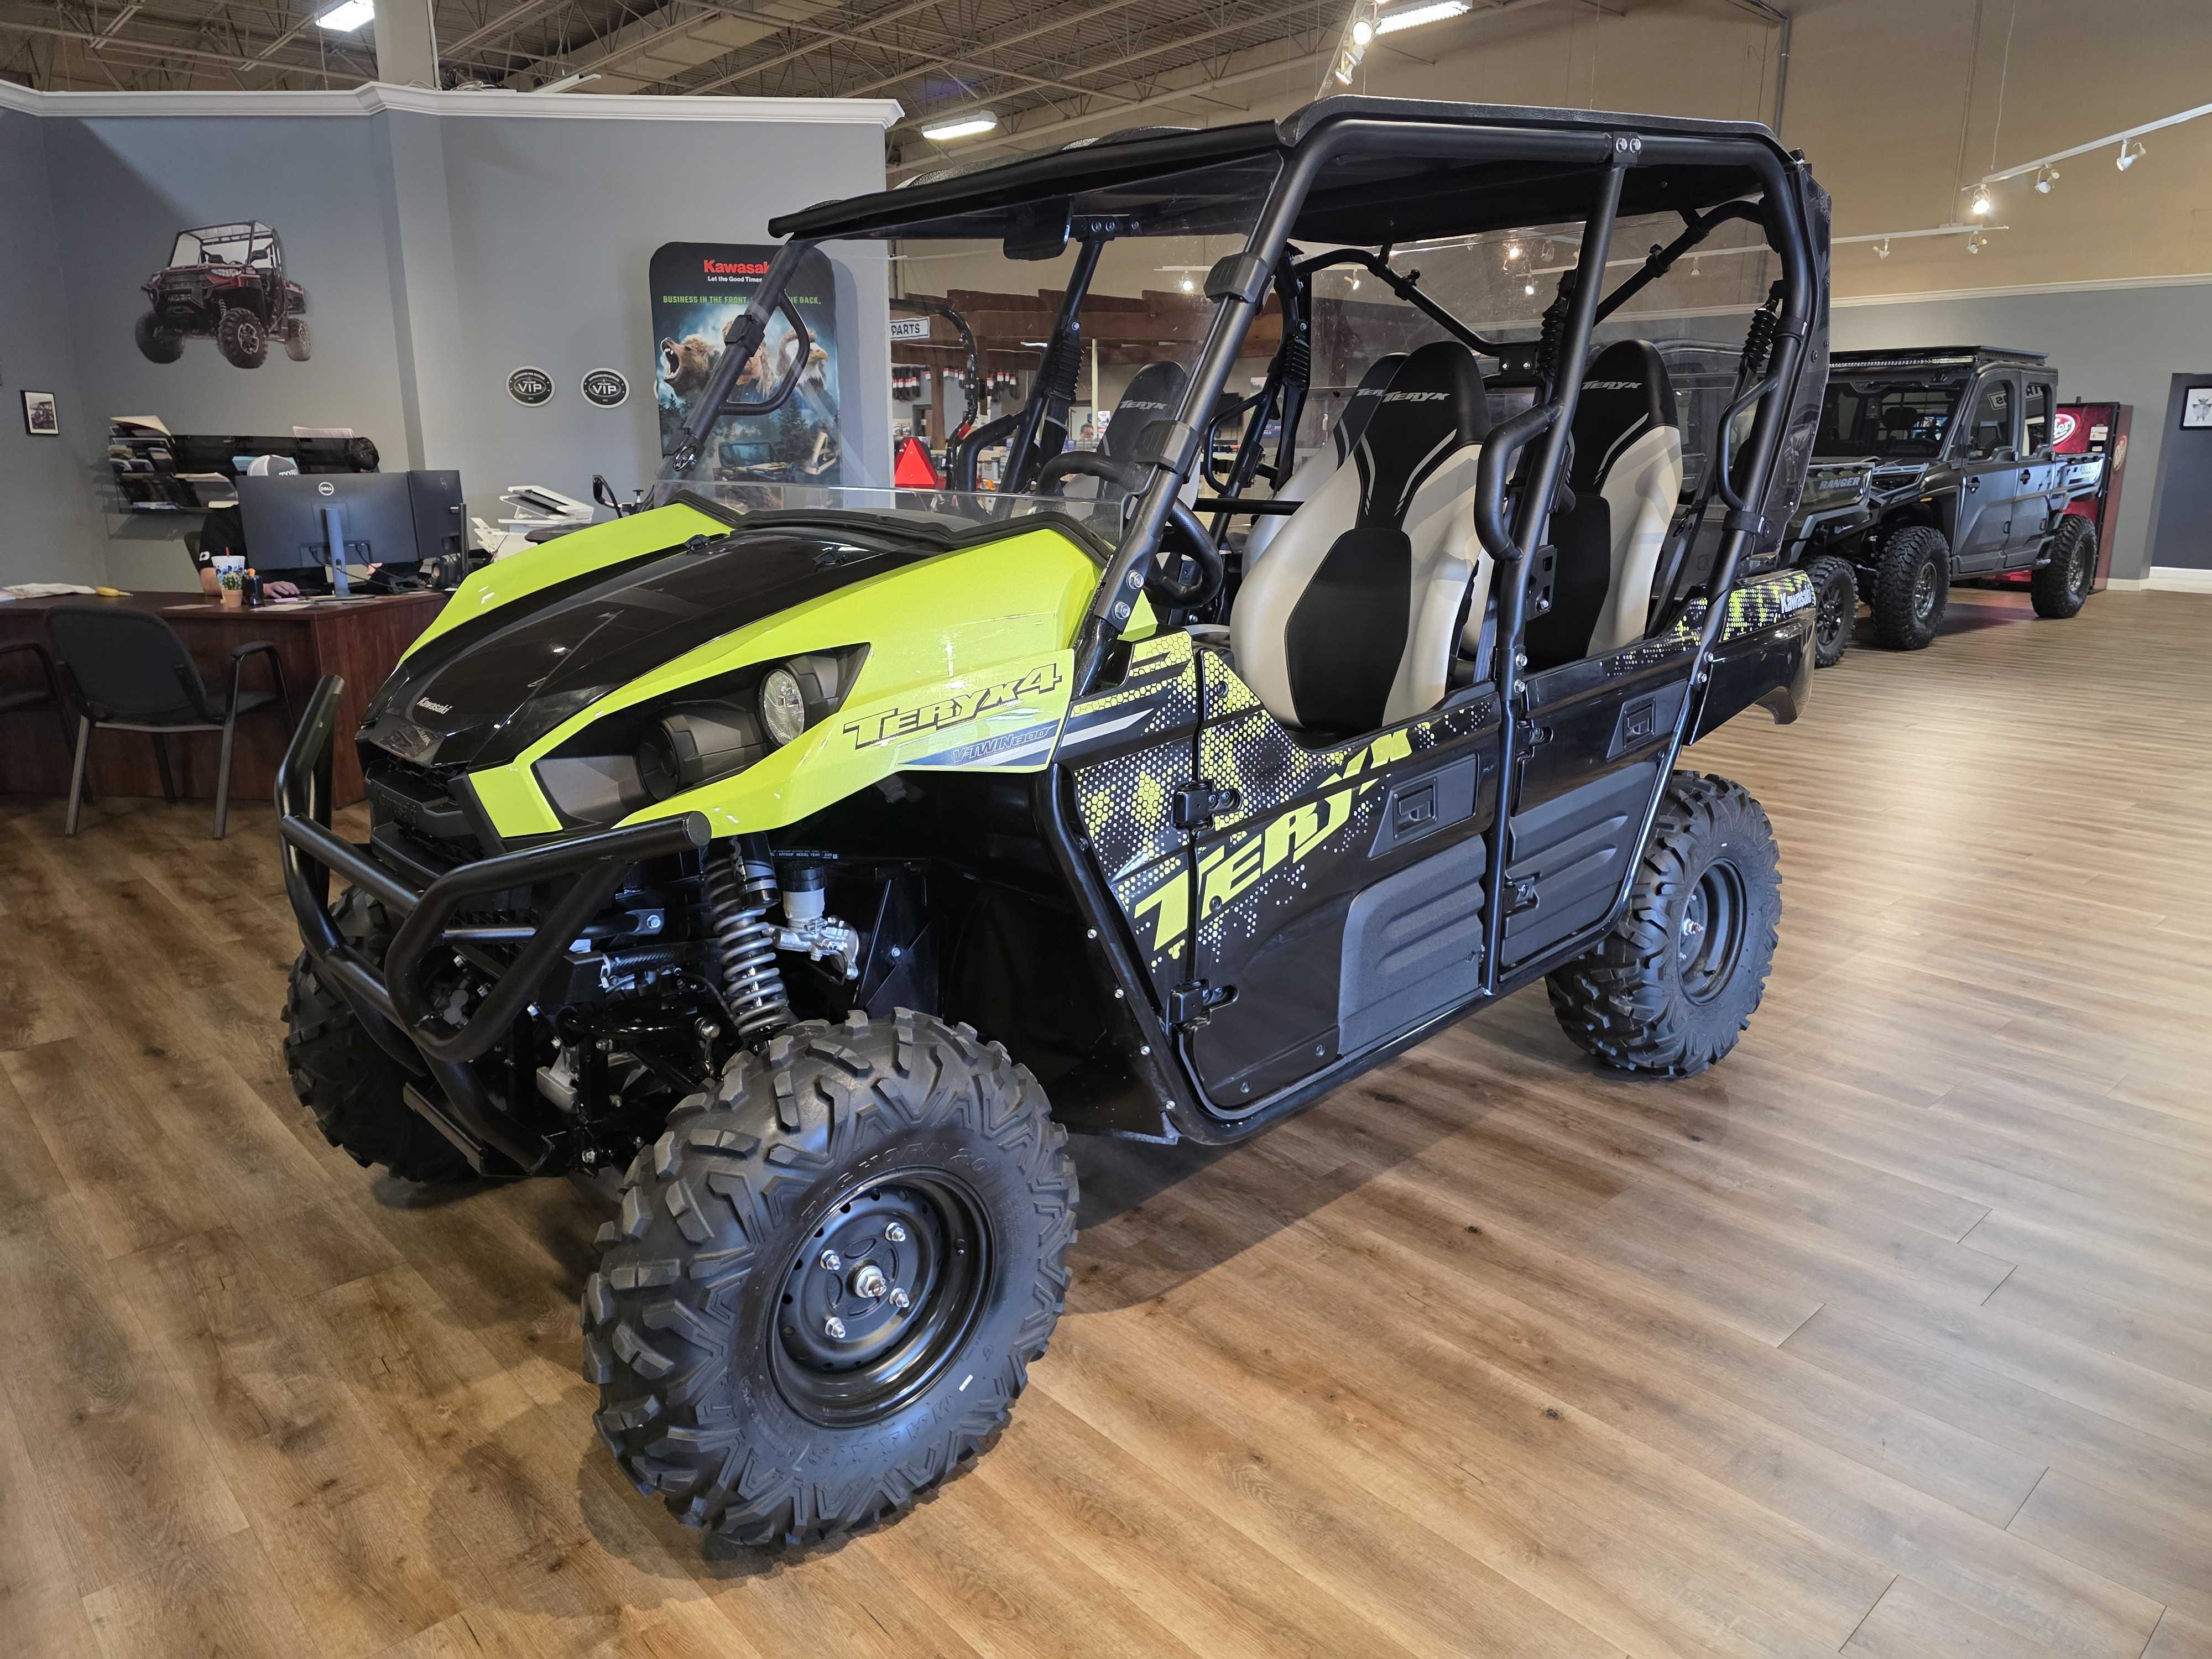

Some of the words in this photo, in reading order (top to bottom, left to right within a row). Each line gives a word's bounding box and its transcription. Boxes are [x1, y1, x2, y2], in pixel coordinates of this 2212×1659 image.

[703, 259, 770, 274] Kawasak
[663, 295, 698, 304] BUSINESS
[799, 296, 821, 305] BACK.
[891, 324, 920, 336] PARTS
[518, 383, 542, 393] VIP
[592, 385, 617, 394] VIP
[1581, 380, 1643, 390] TERYX
[1357, 388, 1384, 397] TER
[1383, 391, 1451, 403] TERYX
[1119, 400, 1168, 410] TERYX
[1818, 477, 1861, 490] RANGER
[1780, 583, 1812, 614] Kawasaki
[416, 697, 453, 714] Kawasaki
[842, 663, 1062, 750] TERYX4
